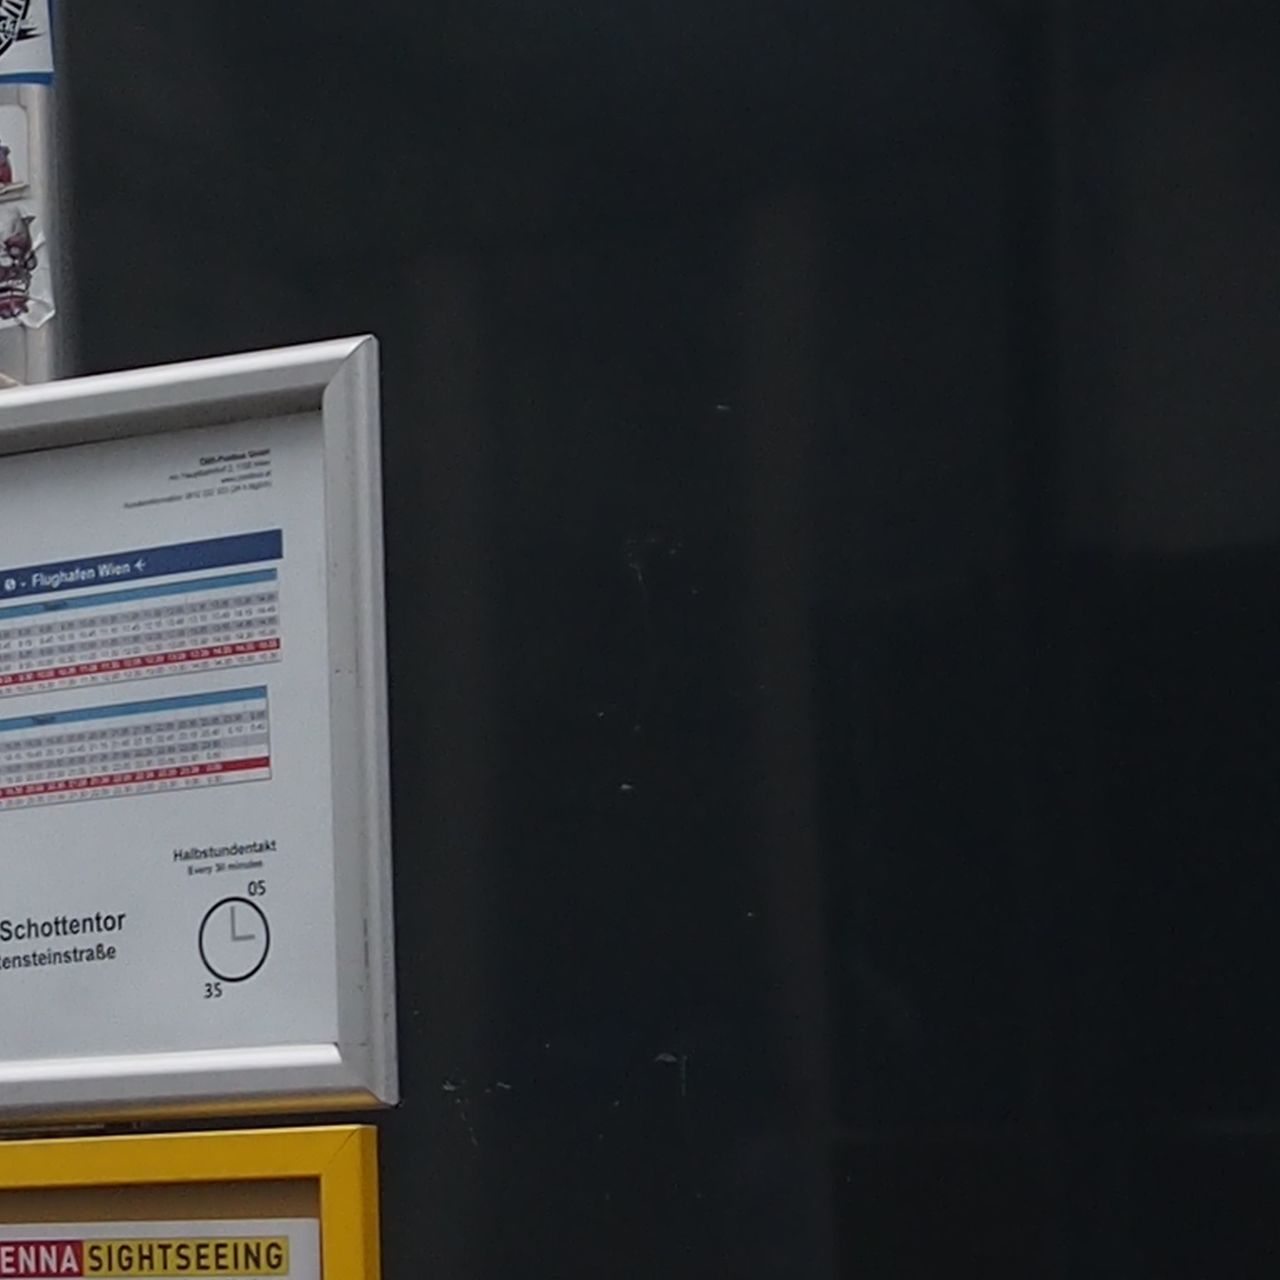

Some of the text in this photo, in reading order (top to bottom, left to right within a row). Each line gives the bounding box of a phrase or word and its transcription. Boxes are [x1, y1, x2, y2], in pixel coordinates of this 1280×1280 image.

[173, 839, 277, 862] Halbstundentakt
[247, 879, 266, 897] 05
[0, 912, 126, 942] Schottentor
[203, 981, 222, 999] 35
[87, 1241, 284, 1272] SIGHTSEEING
